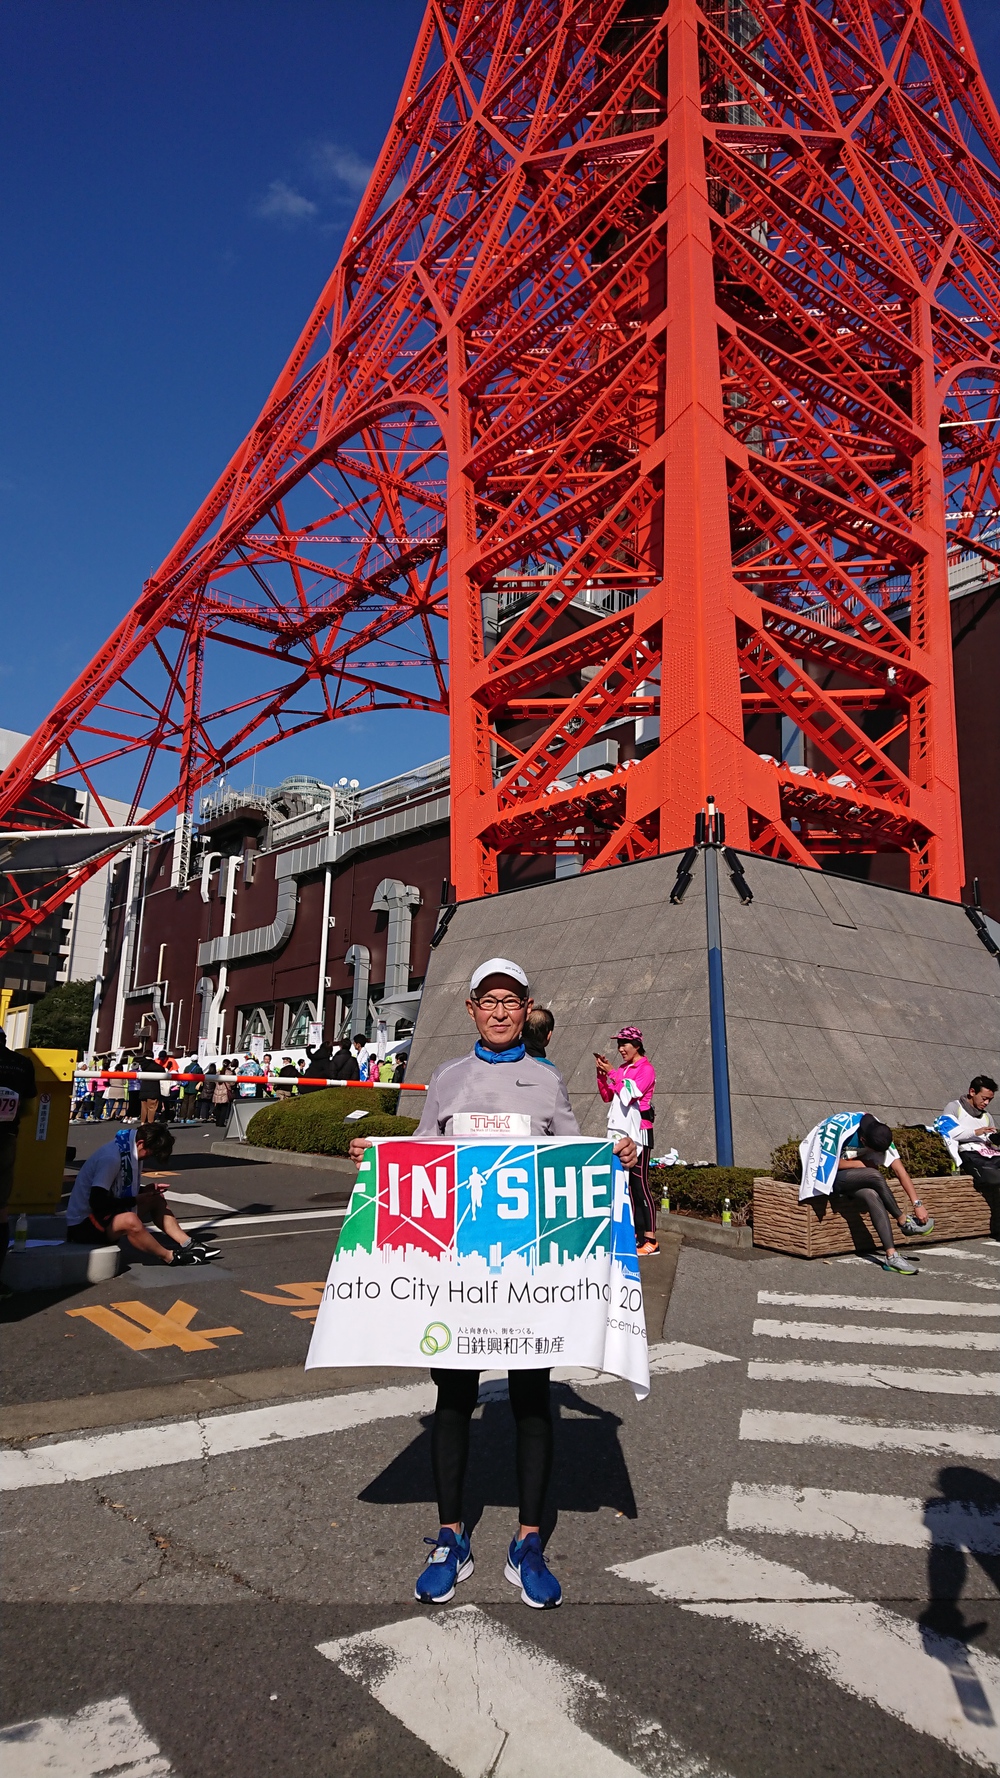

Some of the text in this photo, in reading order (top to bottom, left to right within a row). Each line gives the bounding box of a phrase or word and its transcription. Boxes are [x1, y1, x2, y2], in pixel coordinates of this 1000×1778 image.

[0, 1098, 16, 1112] 79
[470, 1115, 510, 1128] THK
[322, 1276, 642, 1312] nato City Half Maratho 20
[457, 1326, 534, 1335] 人と向き合い、街をつくる。
